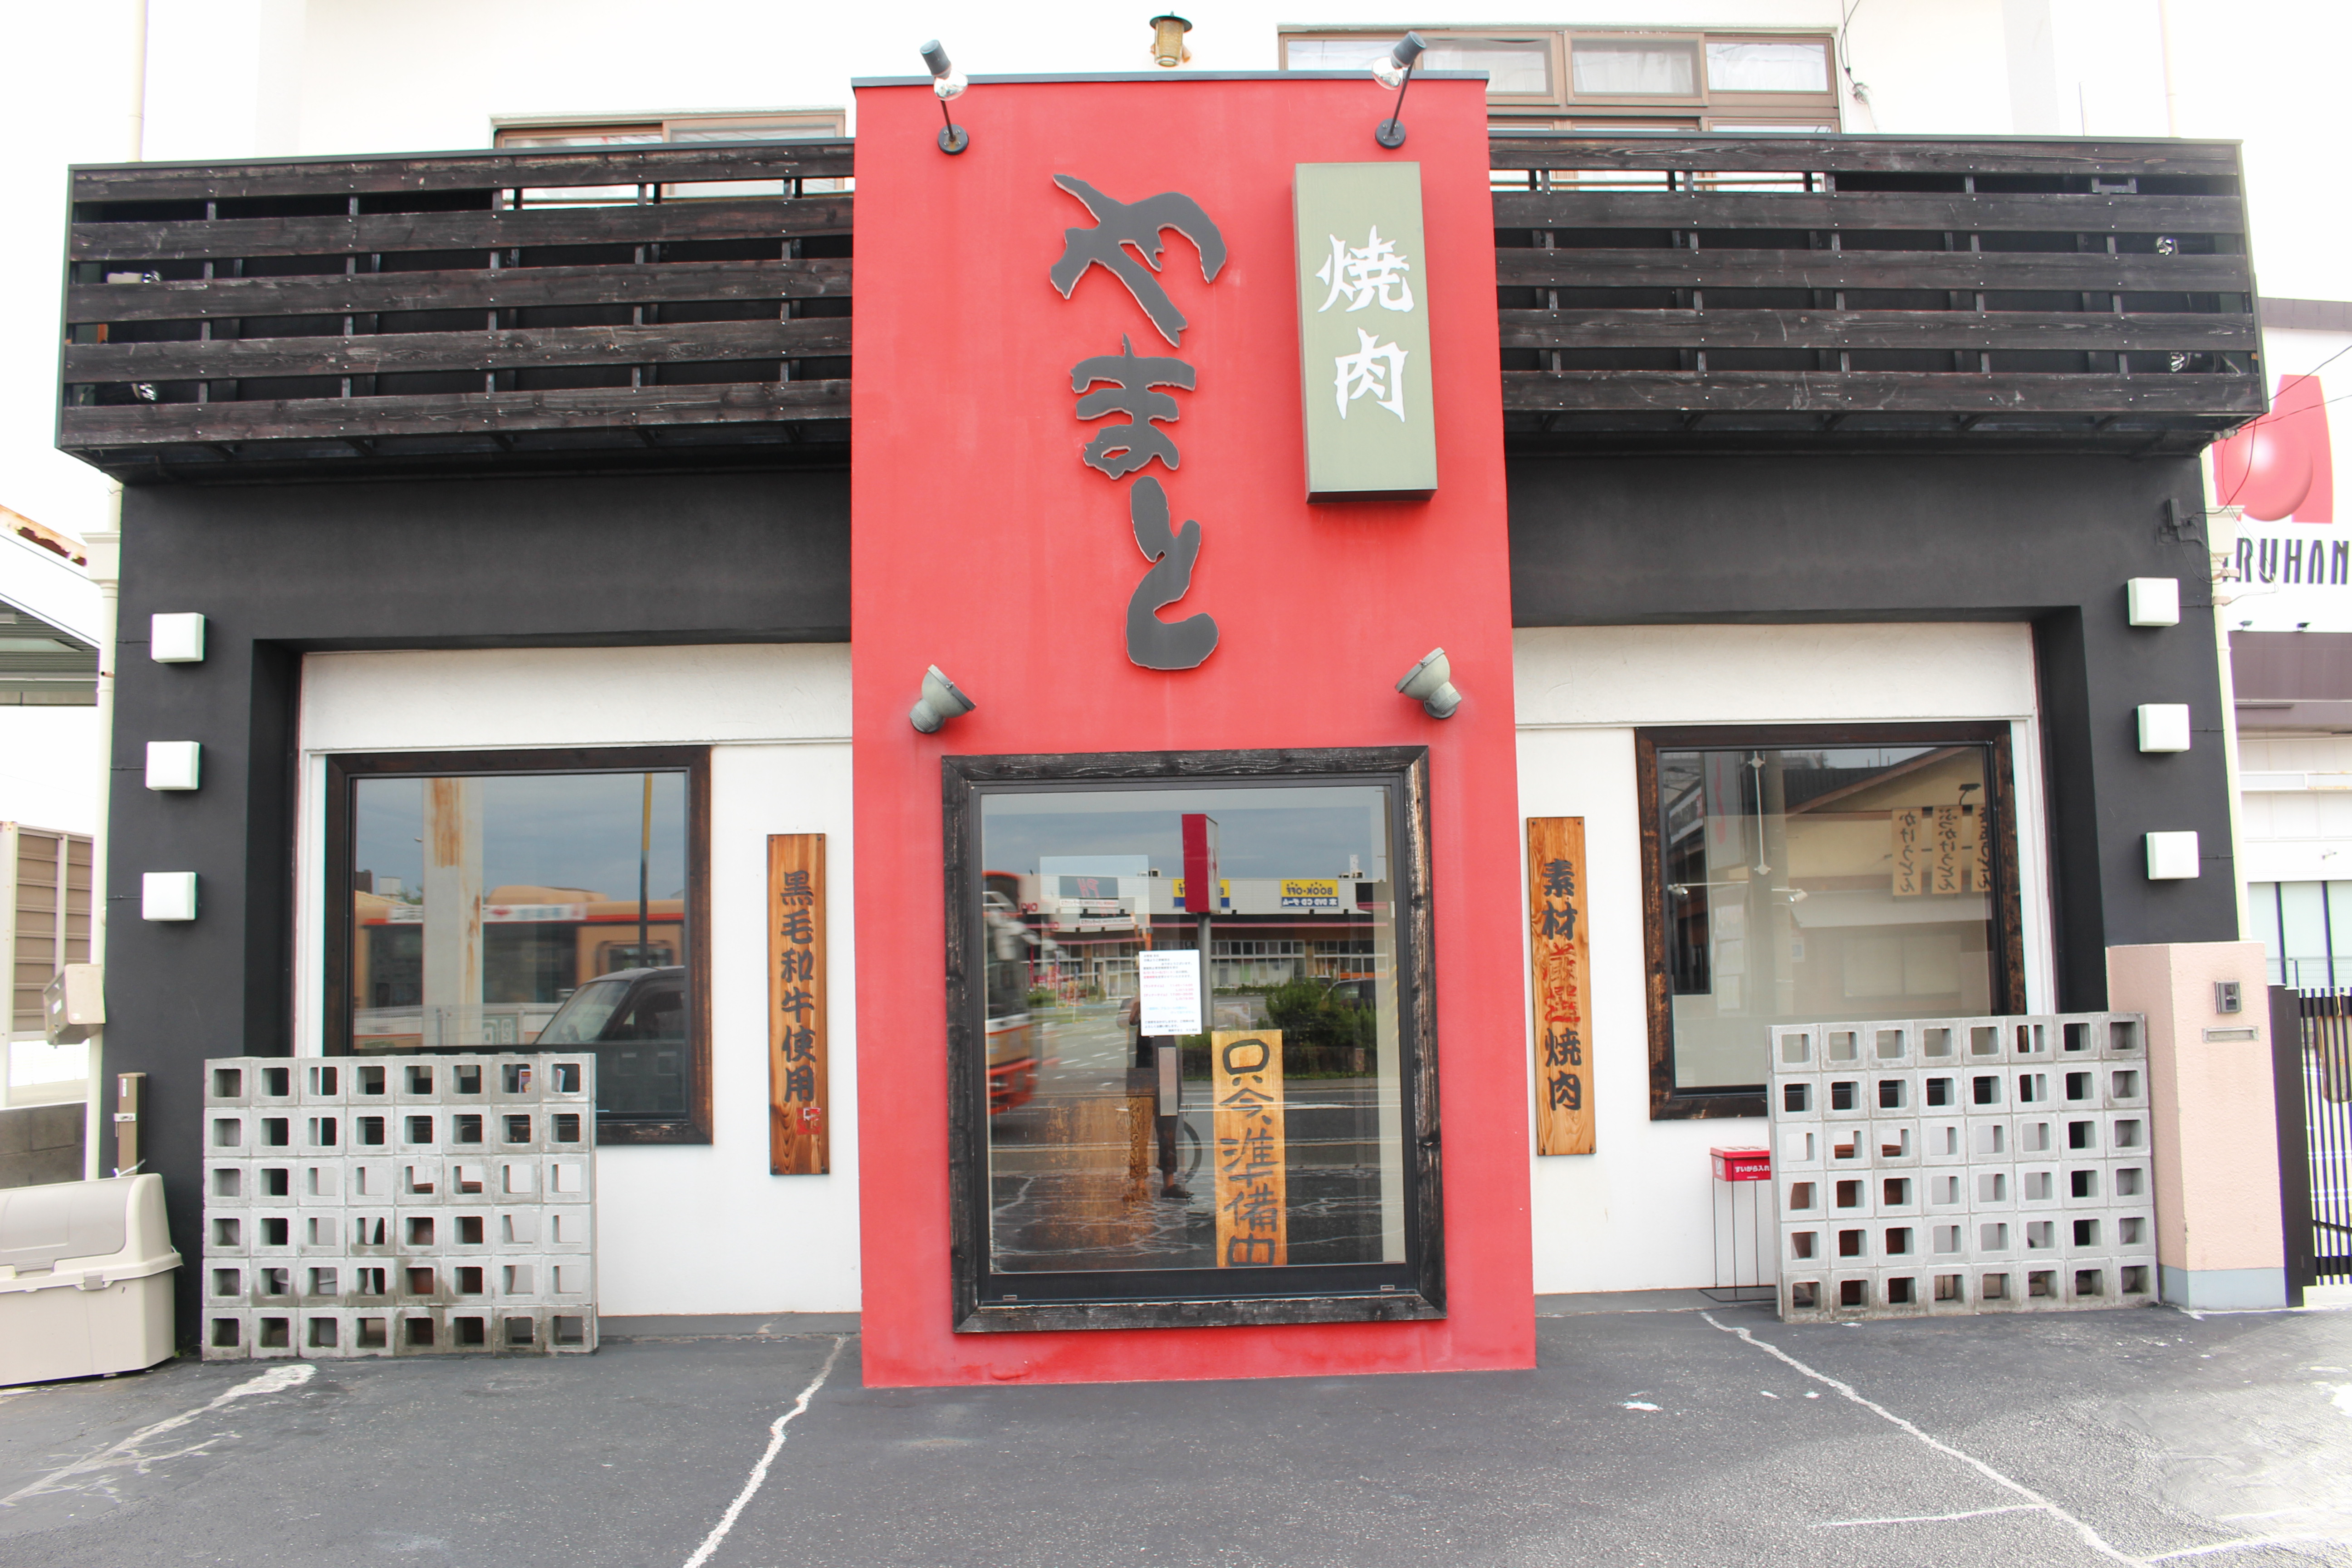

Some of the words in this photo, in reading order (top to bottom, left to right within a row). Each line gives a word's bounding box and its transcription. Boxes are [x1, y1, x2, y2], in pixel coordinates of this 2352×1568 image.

[1050, 174, 1226, 670] やまと
[1316, 225, 1414, 422] 焼肉
[2222, 537, 2349, 585] RUHAN
[780, 871, 816, 1103] 黒毛和牛使用
[1542, 858, 1582, 1111] 素材厳選焼肉
[1219, 1038, 1280, 1267] 只今準備中
